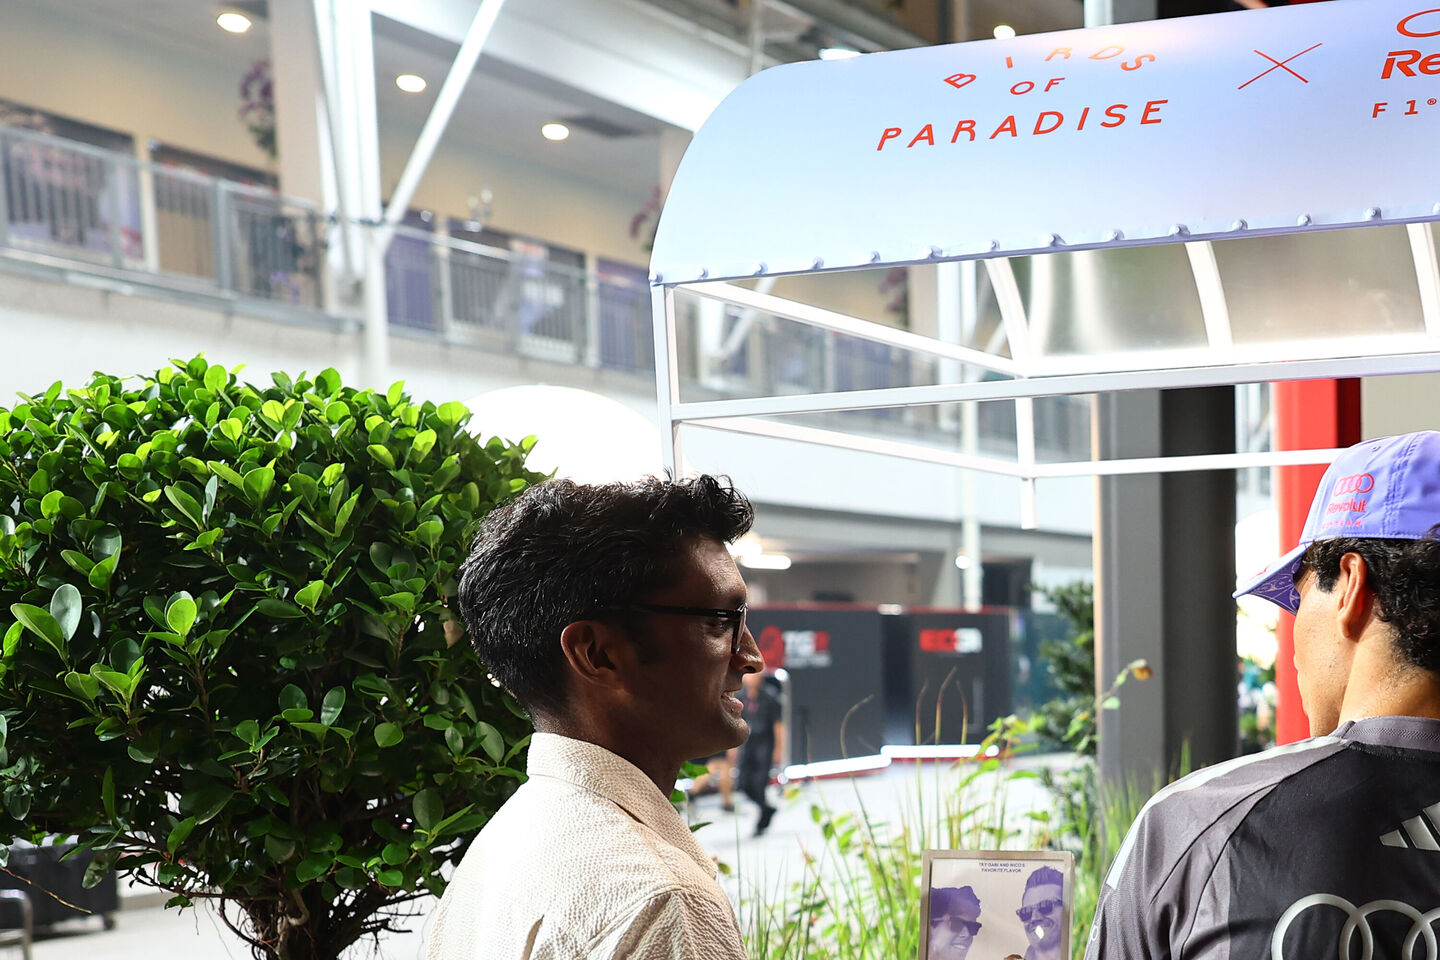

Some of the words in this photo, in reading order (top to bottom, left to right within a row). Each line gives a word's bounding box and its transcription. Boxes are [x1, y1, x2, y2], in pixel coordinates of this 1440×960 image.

[943, 45, 1156, 89] BIRDS
[1009, 77, 1066, 96] OF
[876, 99, 1169, 152] PARADISE
